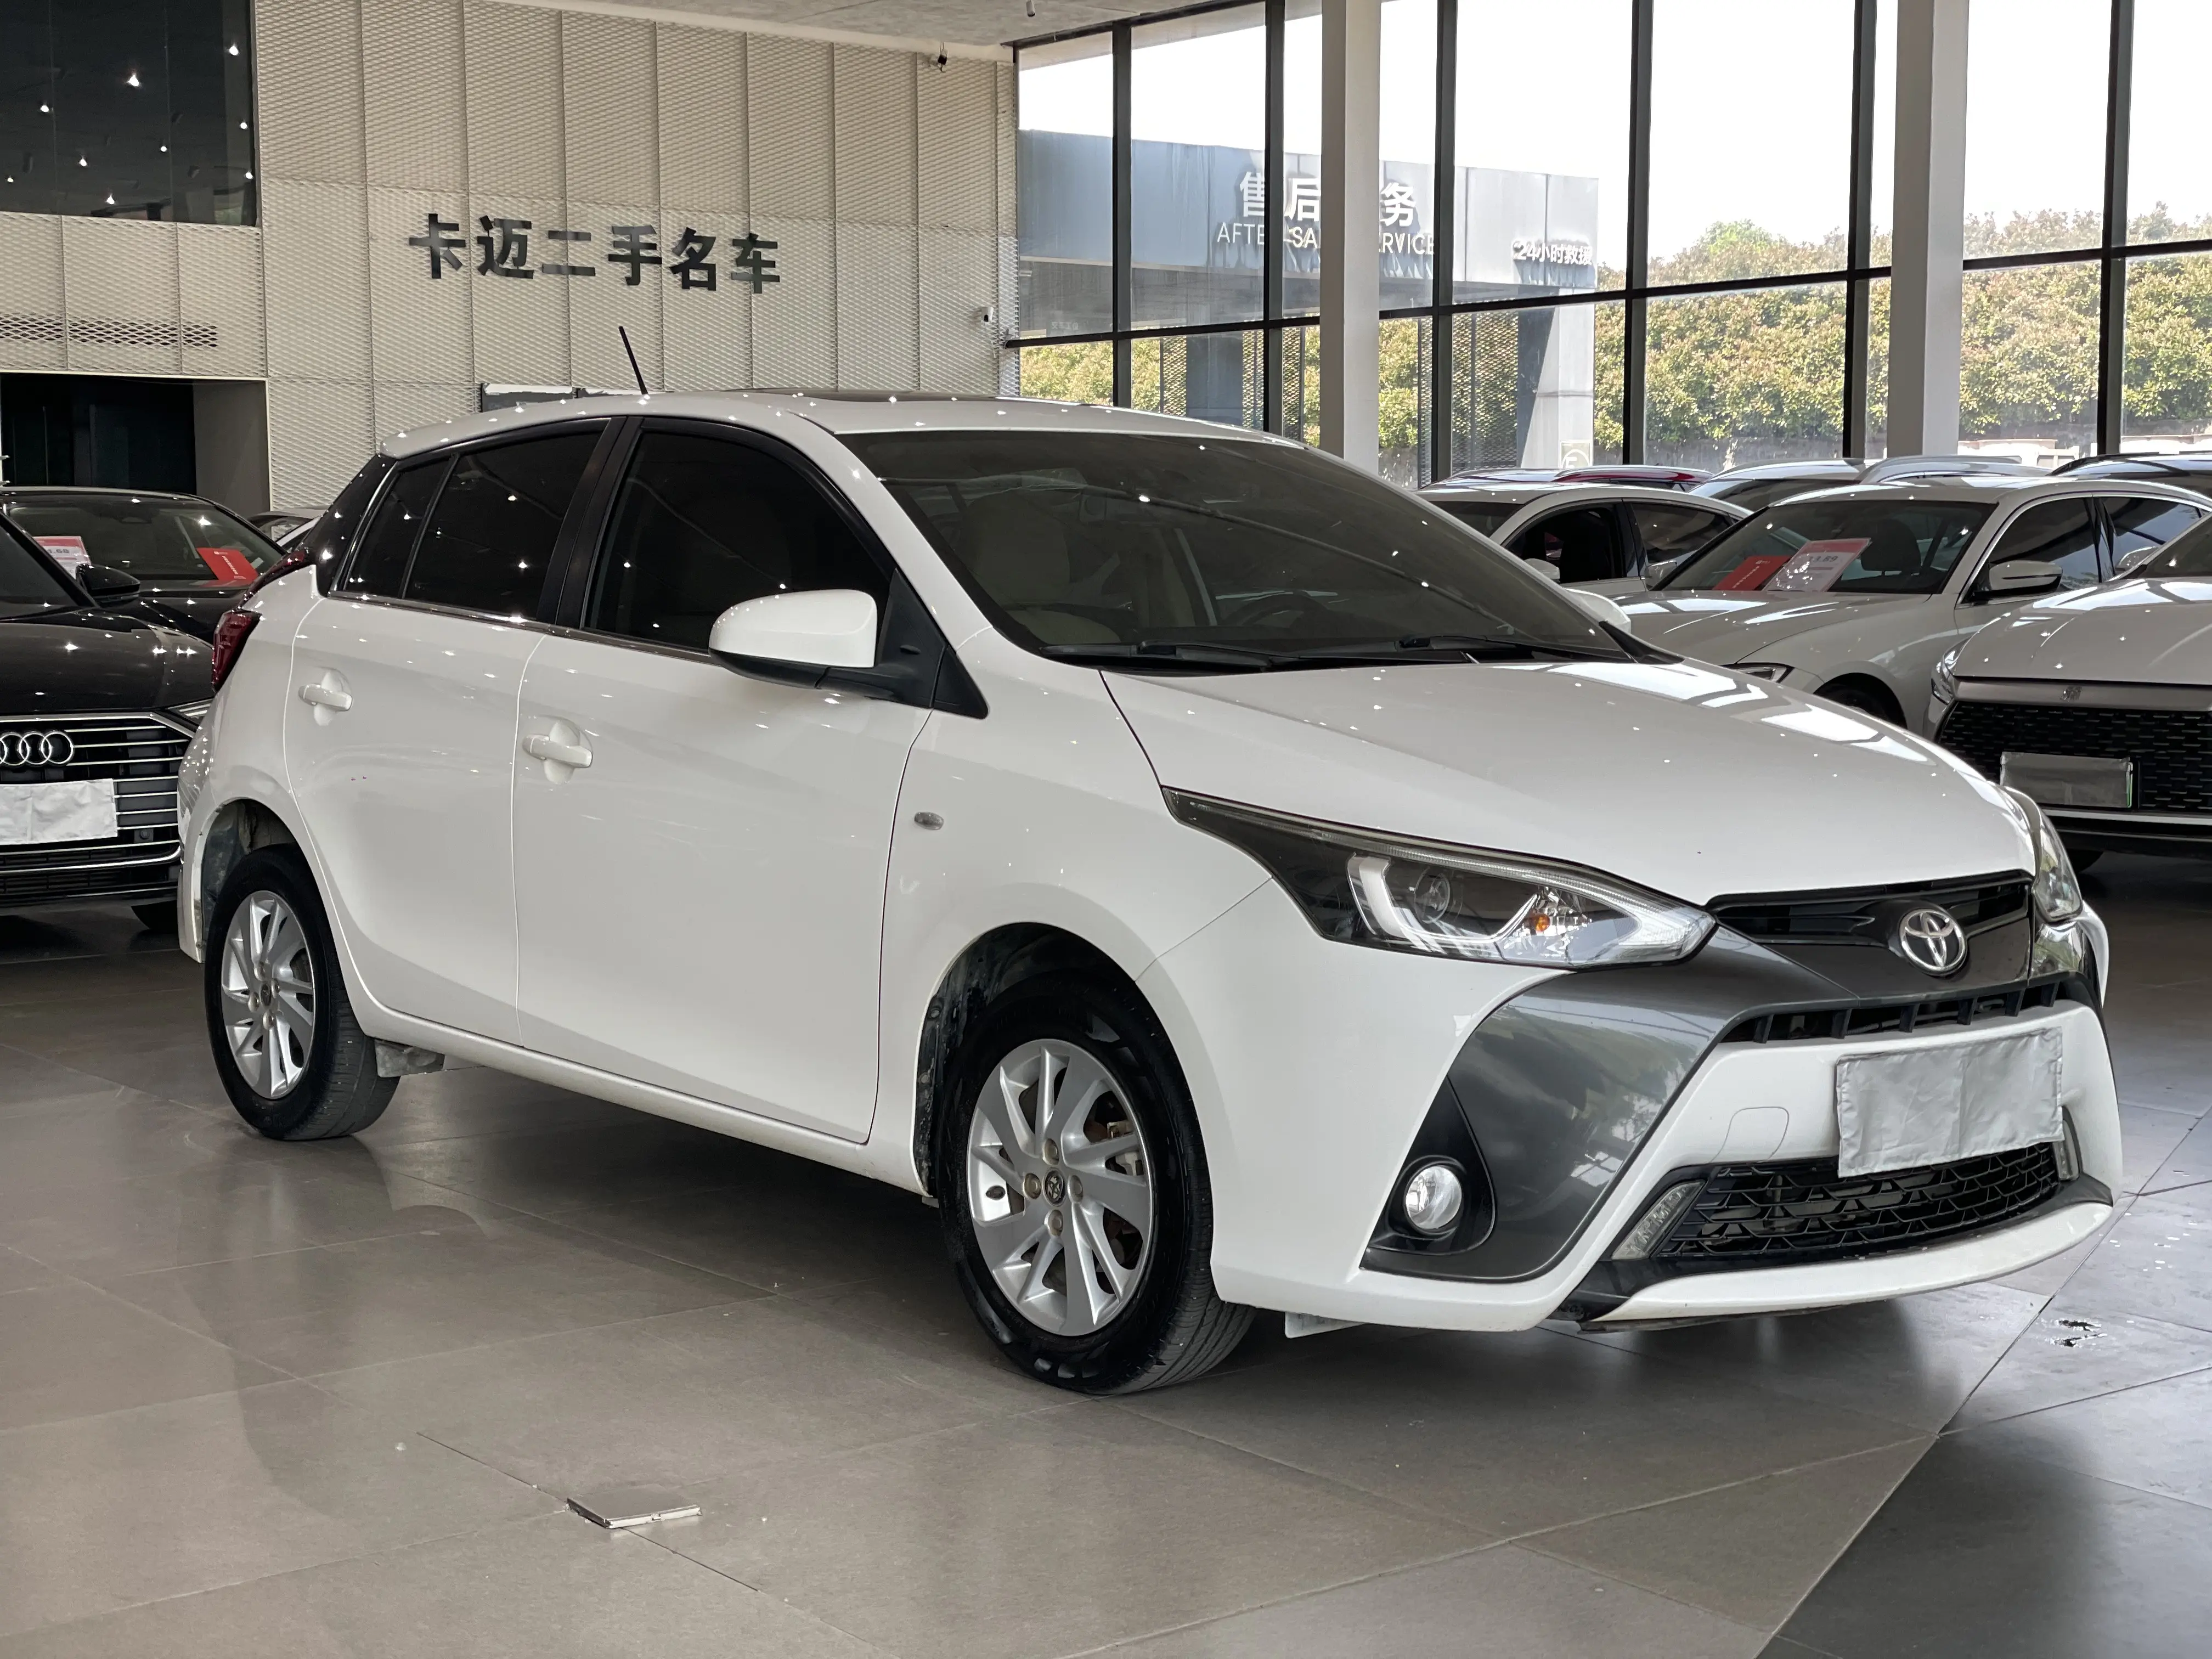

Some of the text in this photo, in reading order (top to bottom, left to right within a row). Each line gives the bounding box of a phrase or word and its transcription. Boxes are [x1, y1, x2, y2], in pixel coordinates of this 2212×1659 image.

[1240, 171, 1416, 227] 售后务
[409, 213, 780, 294] 卡迈二手名车
[1216, 221, 1265, 245] AFTE
[1378, 232, 1434, 255] RVICE
[1514, 241, 1592, 266] 24小时救援
